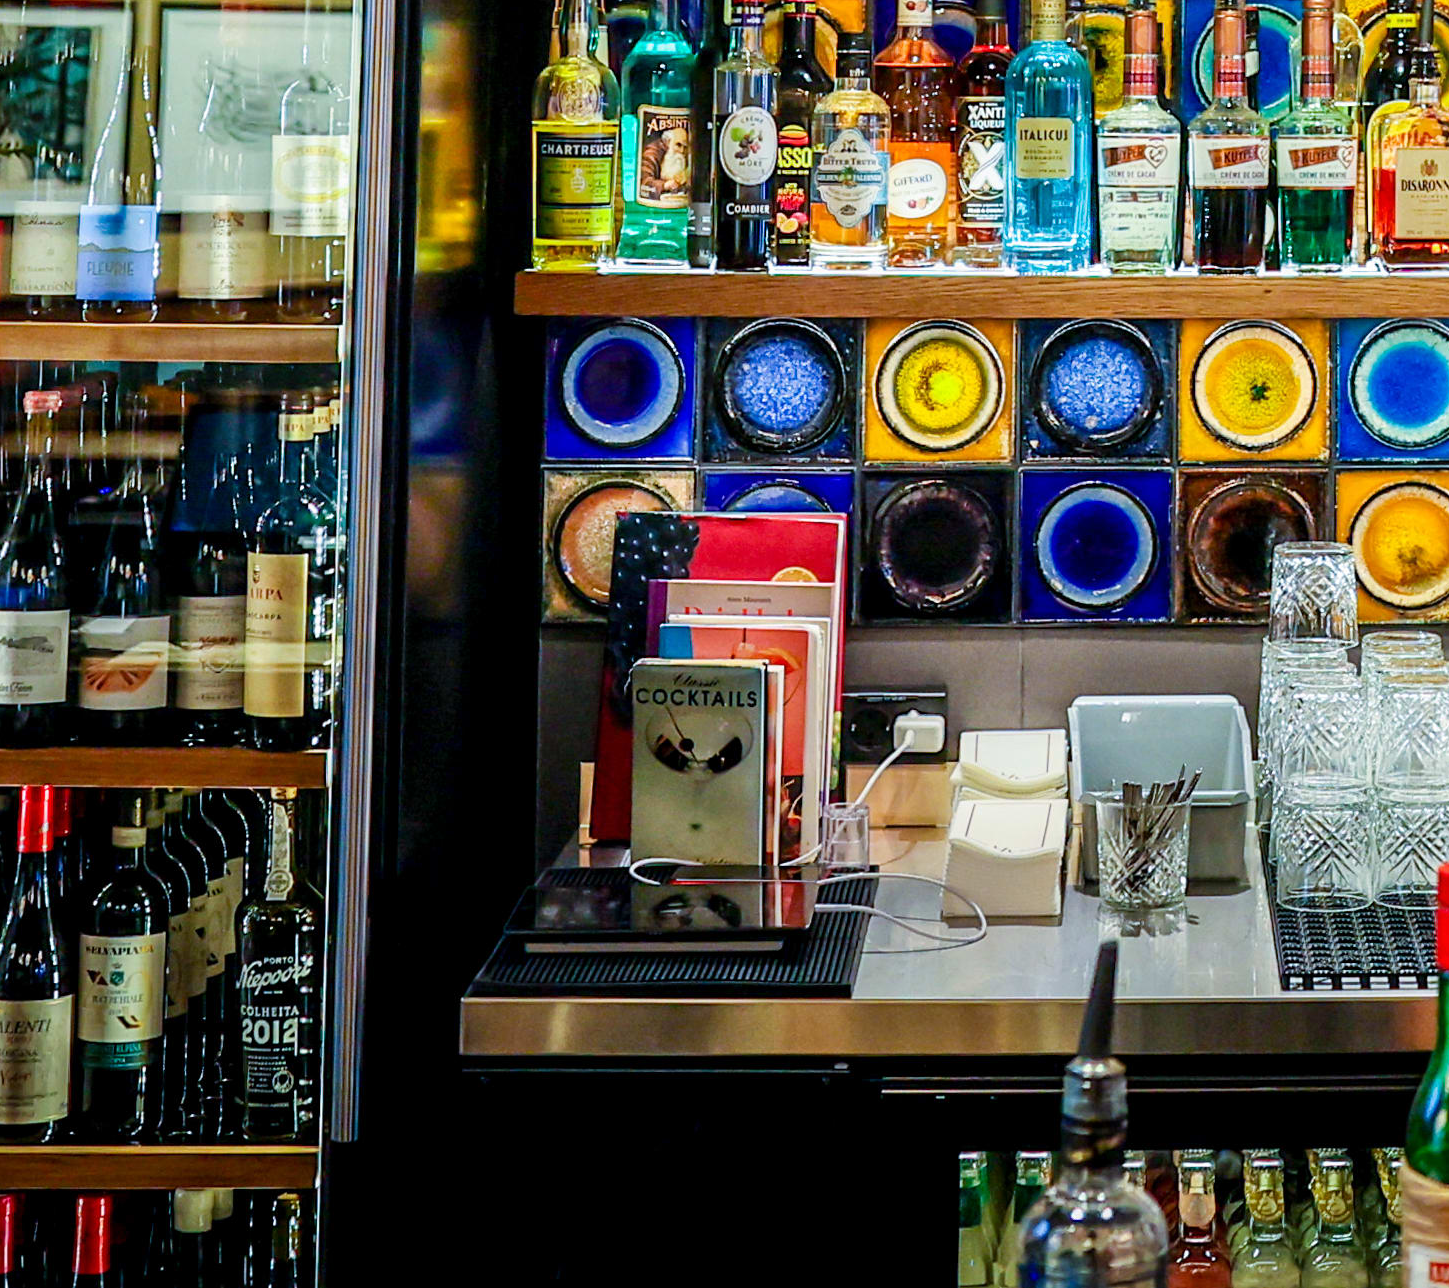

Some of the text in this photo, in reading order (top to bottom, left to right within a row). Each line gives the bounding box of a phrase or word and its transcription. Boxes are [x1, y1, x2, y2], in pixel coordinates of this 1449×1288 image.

[1018, 129, 1069, 141] ITALICUS
[540, 142, 615, 156] CHARTREUSE
[893, 174, 933, 188] GIFFARD
[725, 202, 770, 216] COMBIER
[88, 260, 135, 278] FLEURIE
[635, 687, 758, 709] COCKTAILS
[263, 955, 294, 965] PORTO
[235, 958, 314, 995] Niepoort
[240, 1004, 300, 1017] COLHEITA
[241, 1017, 299, 1045] 2012
